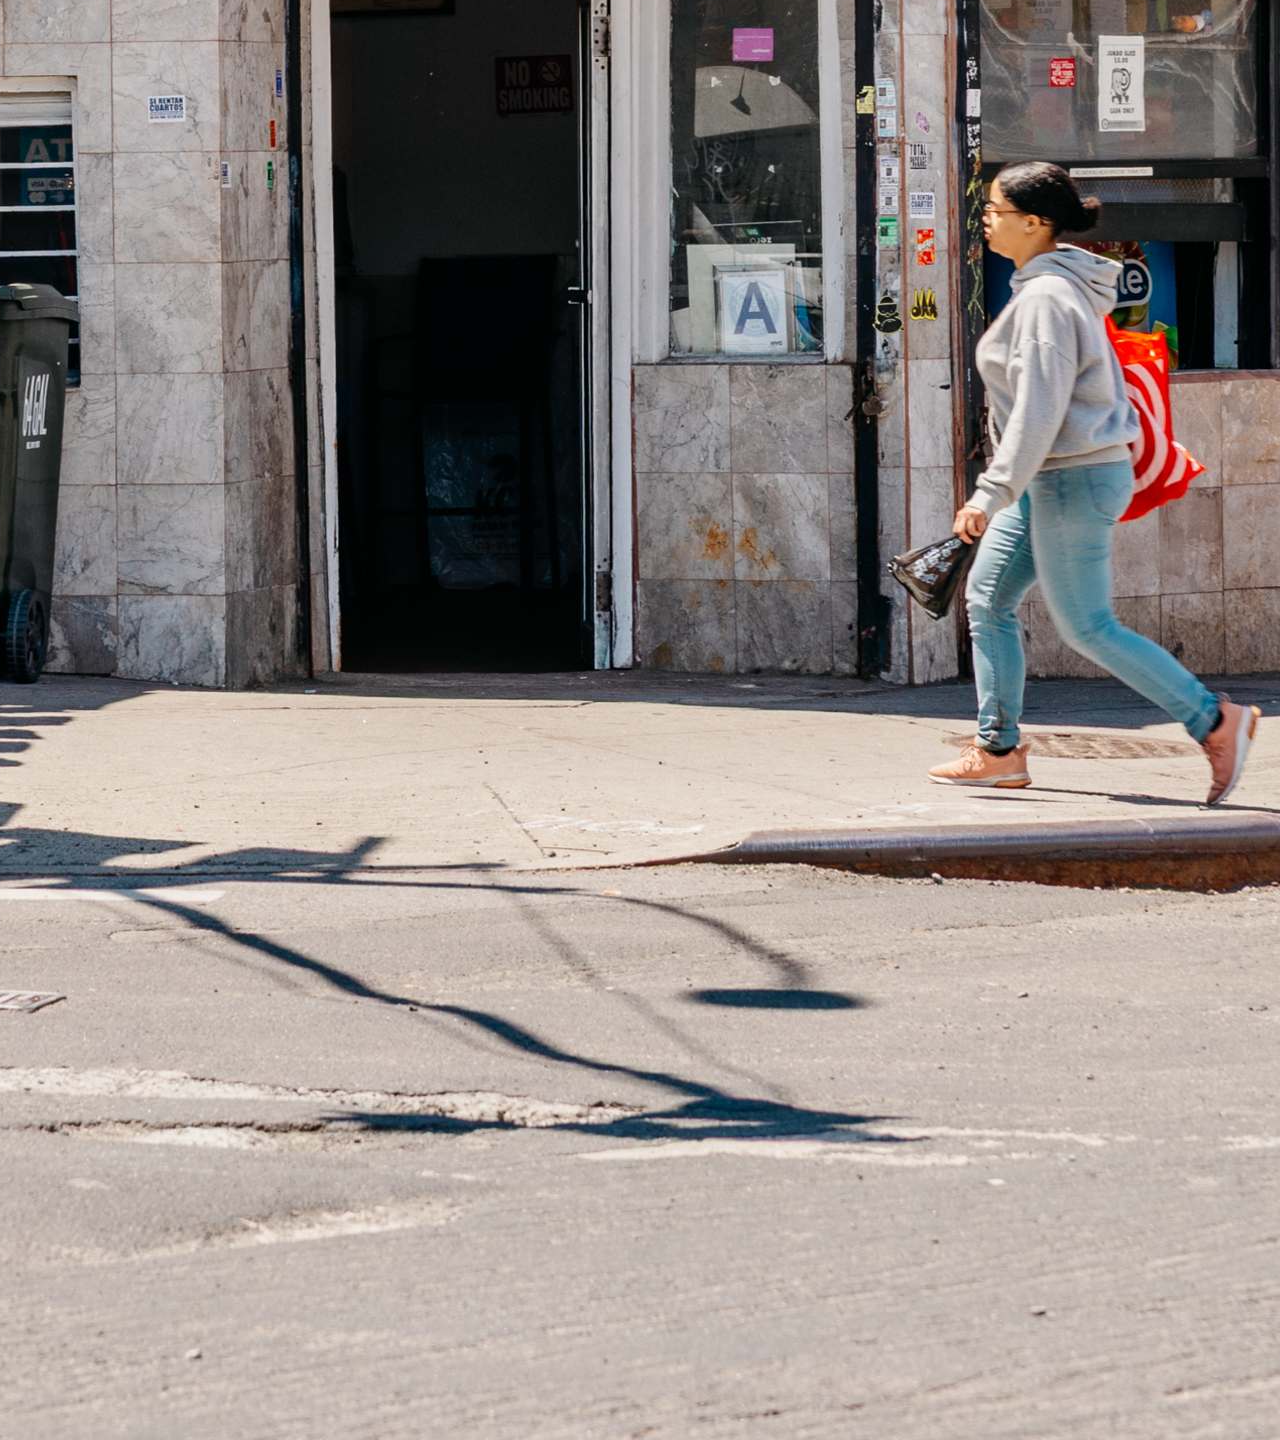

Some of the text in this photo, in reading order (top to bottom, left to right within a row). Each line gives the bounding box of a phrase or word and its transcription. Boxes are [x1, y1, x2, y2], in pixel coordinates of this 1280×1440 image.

[504, 60, 530, 87] NO
[498, 87, 571, 112] SMOKING
[24, 138, 73, 163] AT
[734, 281, 777, 334] A
